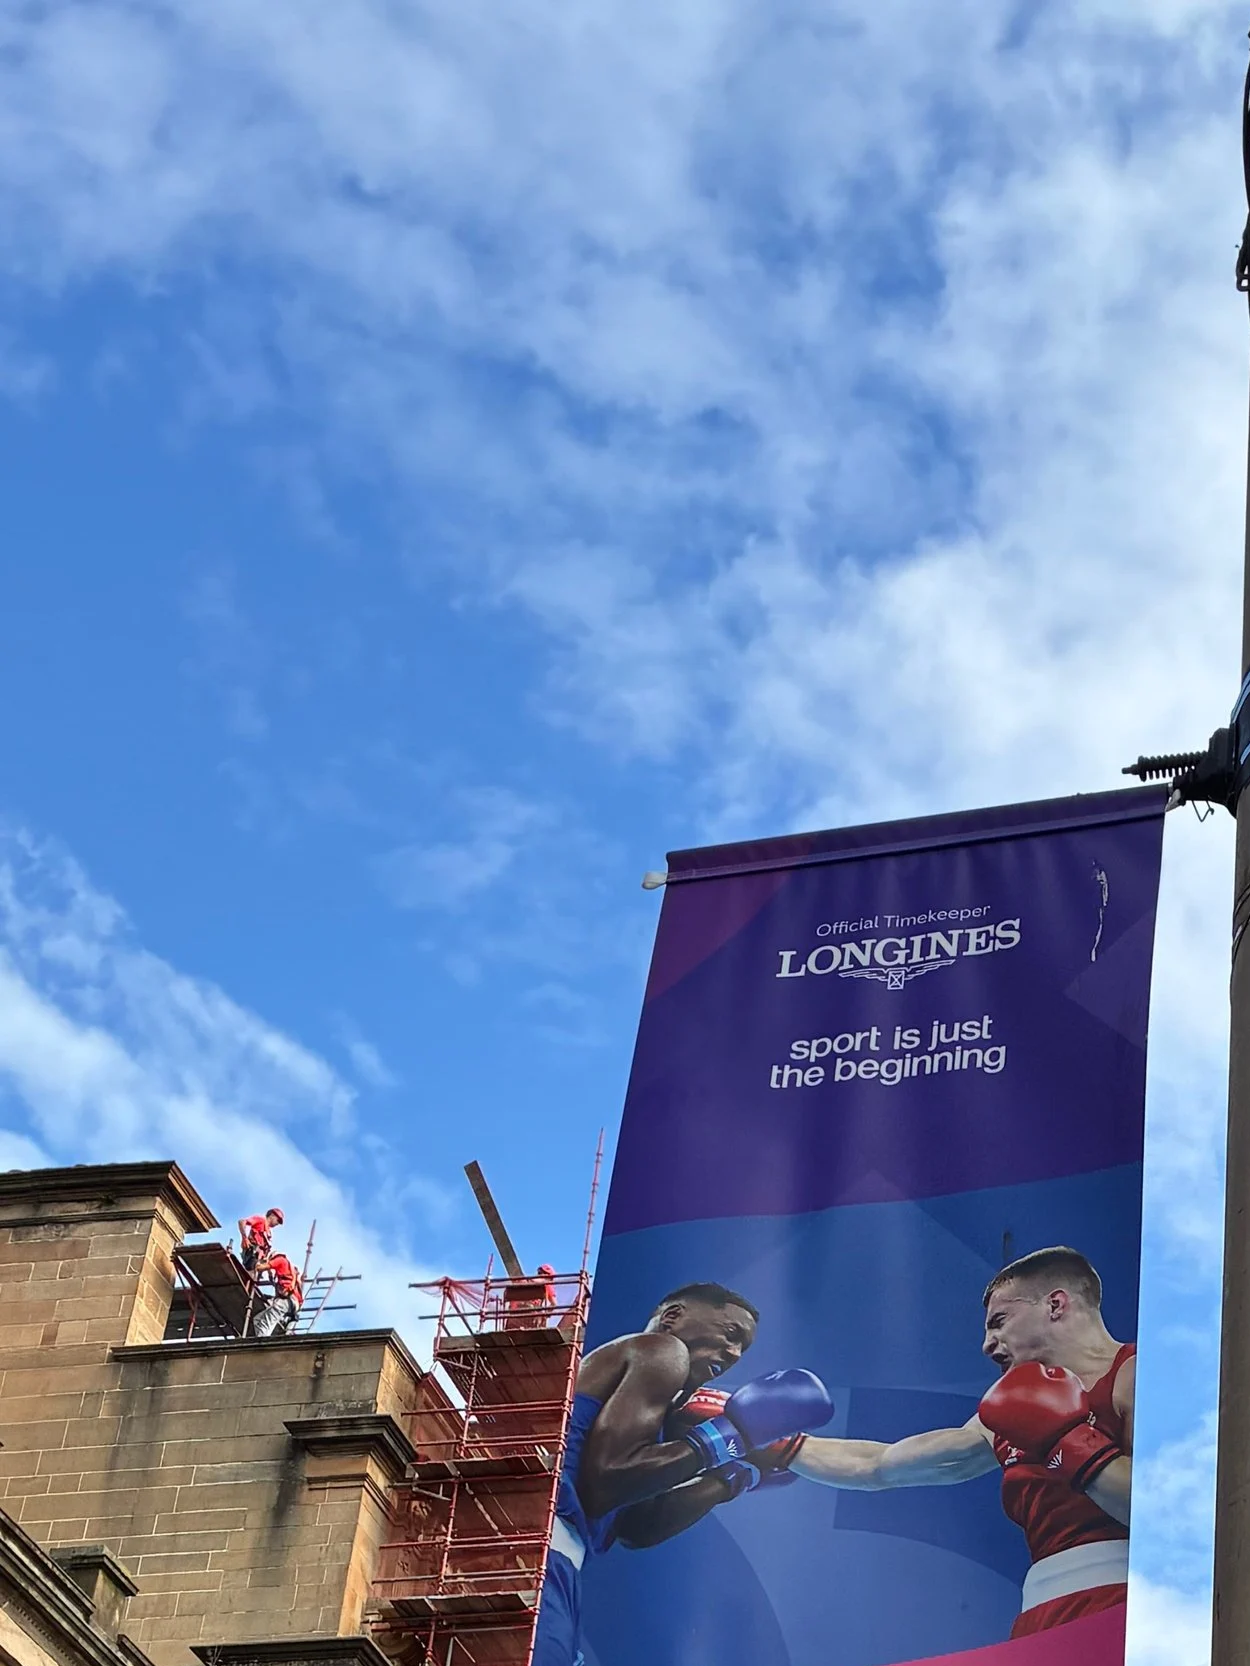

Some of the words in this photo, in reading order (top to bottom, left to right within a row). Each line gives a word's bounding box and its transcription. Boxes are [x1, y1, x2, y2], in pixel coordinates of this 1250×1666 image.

[815, 914, 880, 938] Official
[882, 904, 991, 929] Timekeeper
[776, 918, 1021, 978] LONGINES
[789, 1026, 882, 1063] sport
[893, 1025, 921, 1051] is
[927, 1014, 993, 1052] just
[769, 1063, 826, 1089] the
[834, 1044, 1007, 1086] beginning
